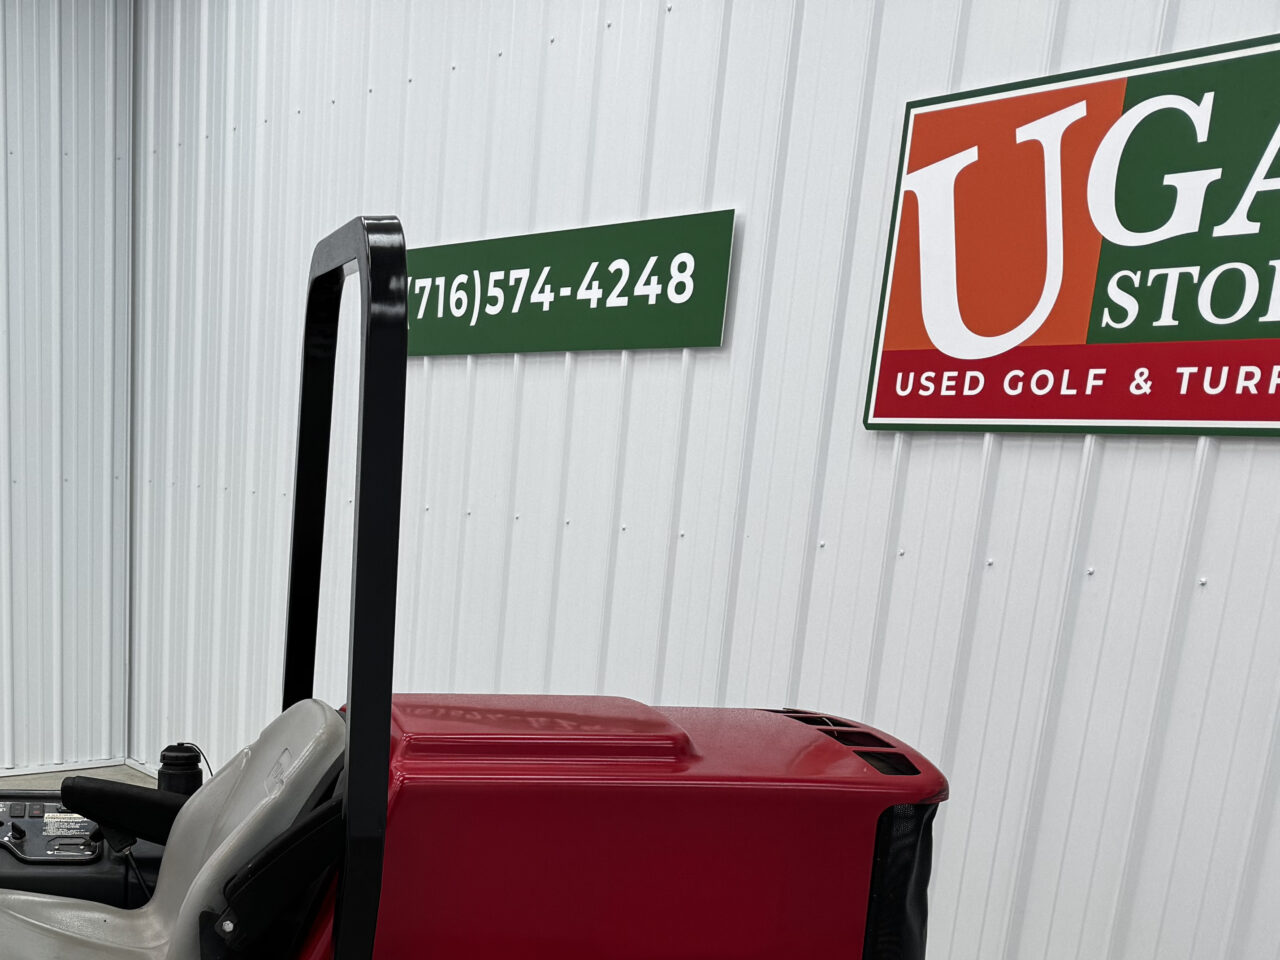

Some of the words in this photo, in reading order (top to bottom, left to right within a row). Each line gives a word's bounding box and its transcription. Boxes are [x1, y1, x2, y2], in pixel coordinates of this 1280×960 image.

[895, 370, 985, 396] USED
[1003, 368, 1107, 396] GOLF
[1129, 367, 1153, 395] &
